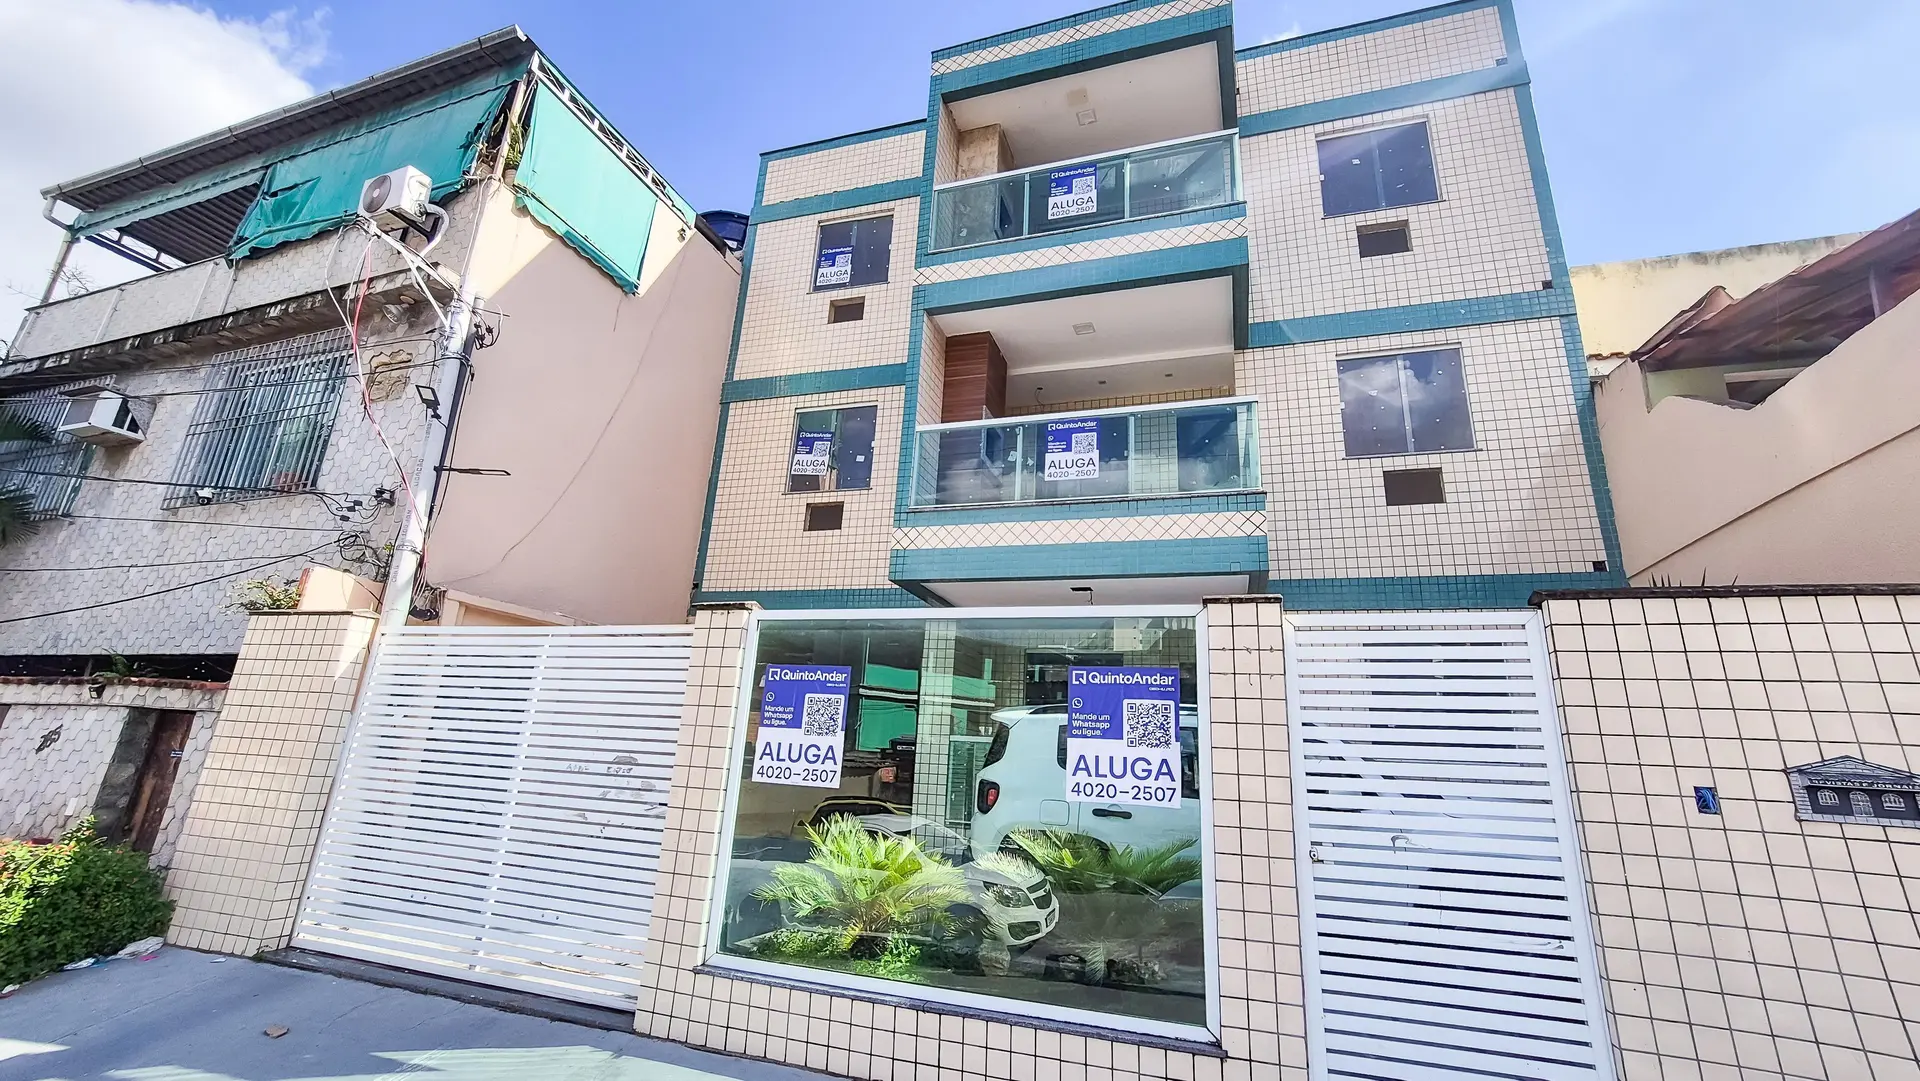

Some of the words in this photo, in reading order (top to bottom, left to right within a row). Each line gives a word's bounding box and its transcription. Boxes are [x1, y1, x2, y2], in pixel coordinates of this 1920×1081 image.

[1058, 167, 1096, 177] QuintoAndar
[1050, 196, 1094, 211] ALUGA
[1050, 205, 1095, 217] 4020-2507
[818, 269, 849, 279] ALUGA
[1055, 421, 1098, 430] QuintoAndar
[794, 459, 826, 468] ALUGA
[1047, 457, 1096, 471] ALUGA
[1046, 469, 1097, 478] 4020-2507
[781, 669, 847, 682] QuintoAndar
[1088, 671, 1175, 686] QuintoAndar
[763, 711, 794, 720] Whatsapp
[1072, 712, 1097, 720] Mande
[1071, 720, 1110, 730] Whatsapp
[1082, 728, 1103, 737] ligue.
[759, 741, 838, 765] ALUGA
[1071, 754, 1176, 782] ALUGA
[756, 765, 838, 783] 4020-2507
[1070, 781, 1177, 803] 4020-2507
